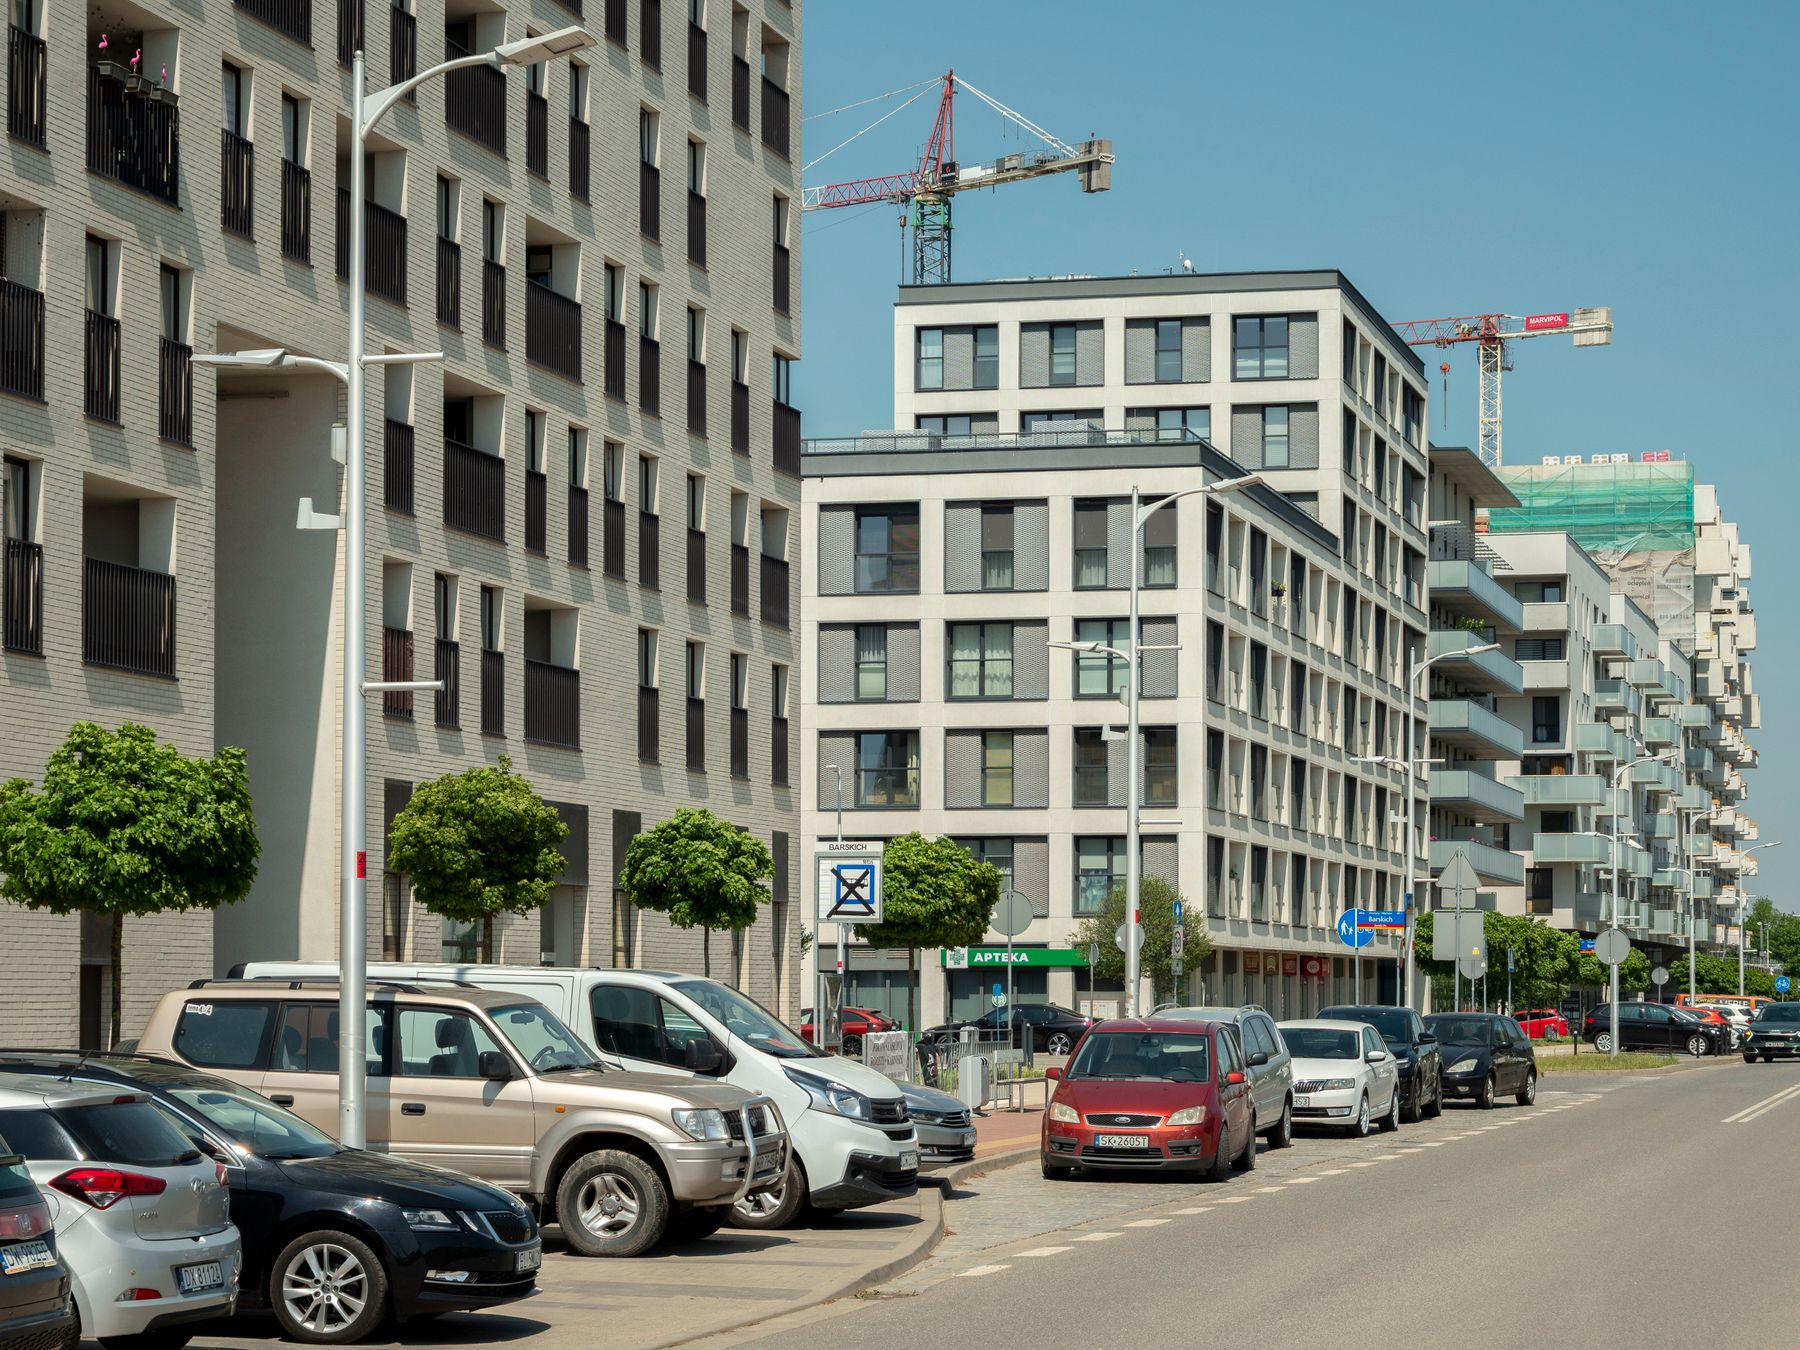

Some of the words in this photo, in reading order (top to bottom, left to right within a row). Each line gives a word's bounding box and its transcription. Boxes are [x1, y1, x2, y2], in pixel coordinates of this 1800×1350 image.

[1530, 315, 1562, 324] MARVIPOL
[829, 843, 867, 851] BARSKICH
[974, 952, 1029, 962] APTEKA
[1101, 1136, 1113, 1146] SK
[1118, 1137, 1147, 1147] 2605T
